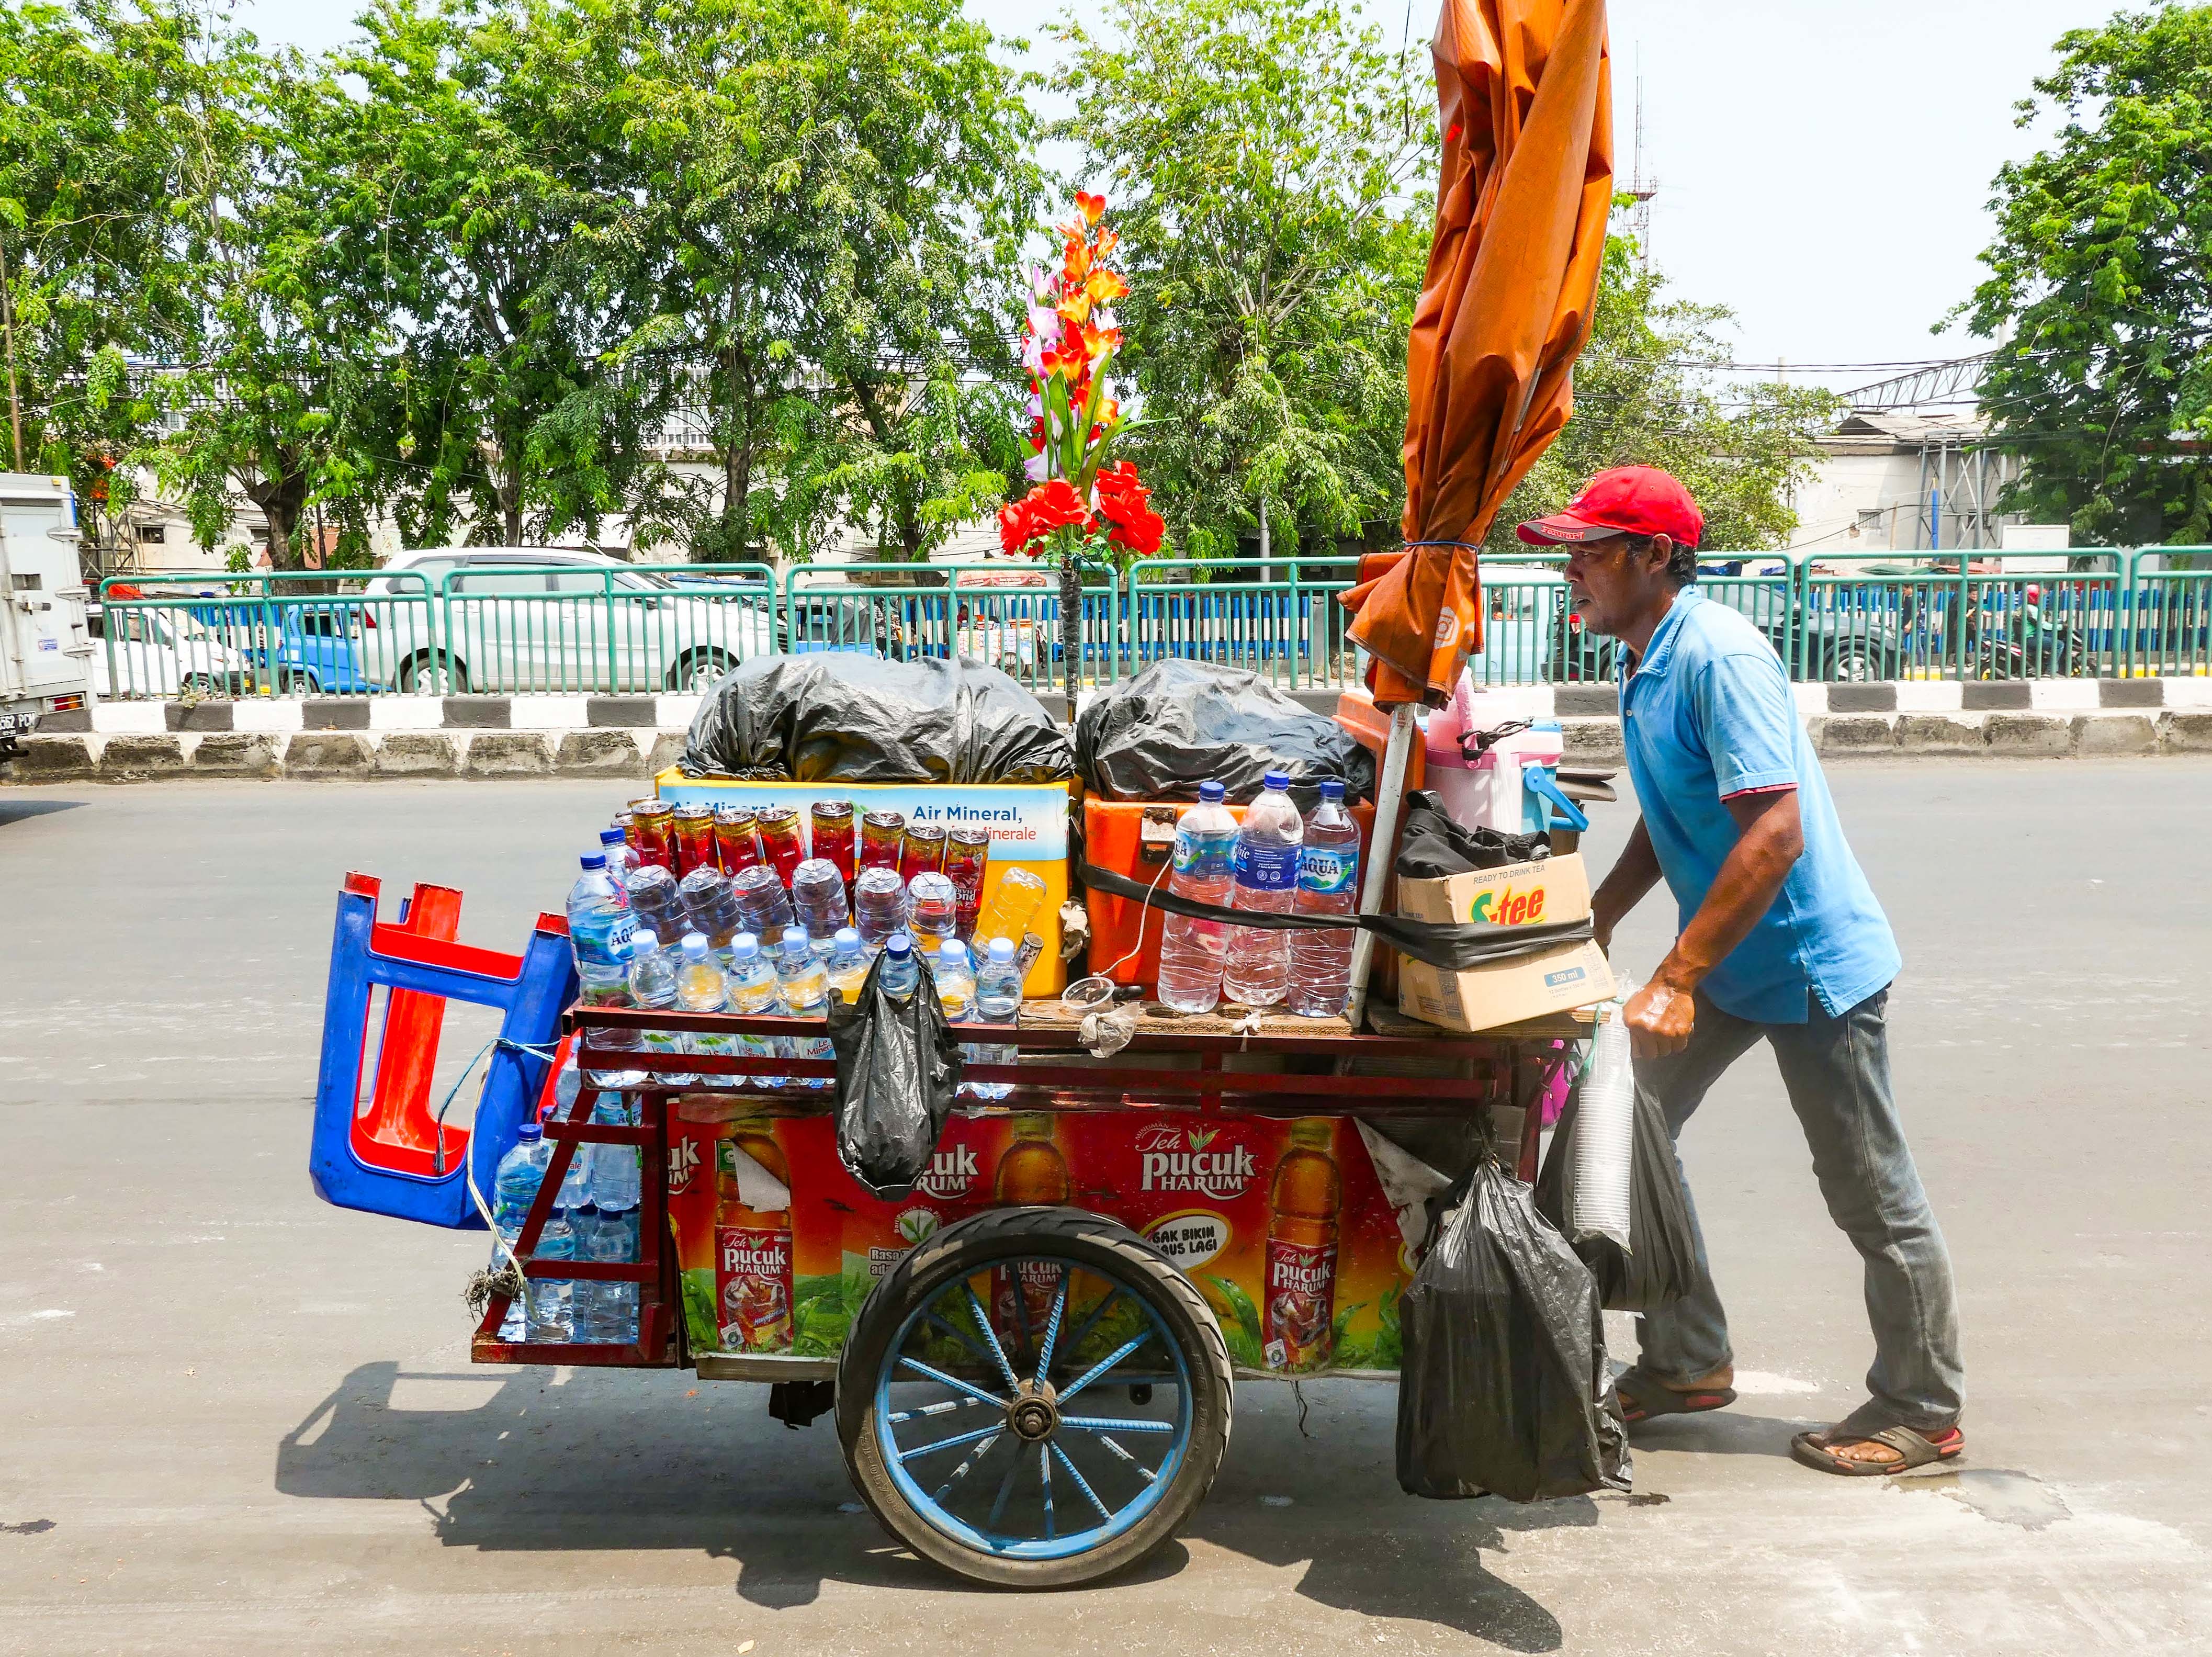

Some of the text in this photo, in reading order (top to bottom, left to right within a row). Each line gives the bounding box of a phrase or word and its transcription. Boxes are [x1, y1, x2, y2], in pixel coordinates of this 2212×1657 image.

[1540, 525, 1585, 540] Ferrari
[912, 806, 1023, 824] Air Mineral,
[1300, 856, 1339, 877] AQUA
[1473, 864, 1545, 885] READY TO DRINK TEA
[1552, 970, 1578, 983] 350 ml
[1135, 1128, 1181, 1152] Teh
[1141, 1145, 1256, 1191] pucuk
[1160, 1176, 1249, 1200] HARUM
[723, 1233, 747, 1248] Teh
[1153, 1225, 1215, 1244] GAK BIKIN
[1159, 1239, 1217, 1256] AUS LAGI
[1273, 1248, 1297, 1264] Teh
[724, 1246, 787, 1272] pucuk
[735, 1263, 781, 1280] HARUM
[1021, 1273, 1057, 1288] ARUM
[1272, 1261, 1331, 1287] pucuk
[1283, 1278, 1325, 1298] HARUM
